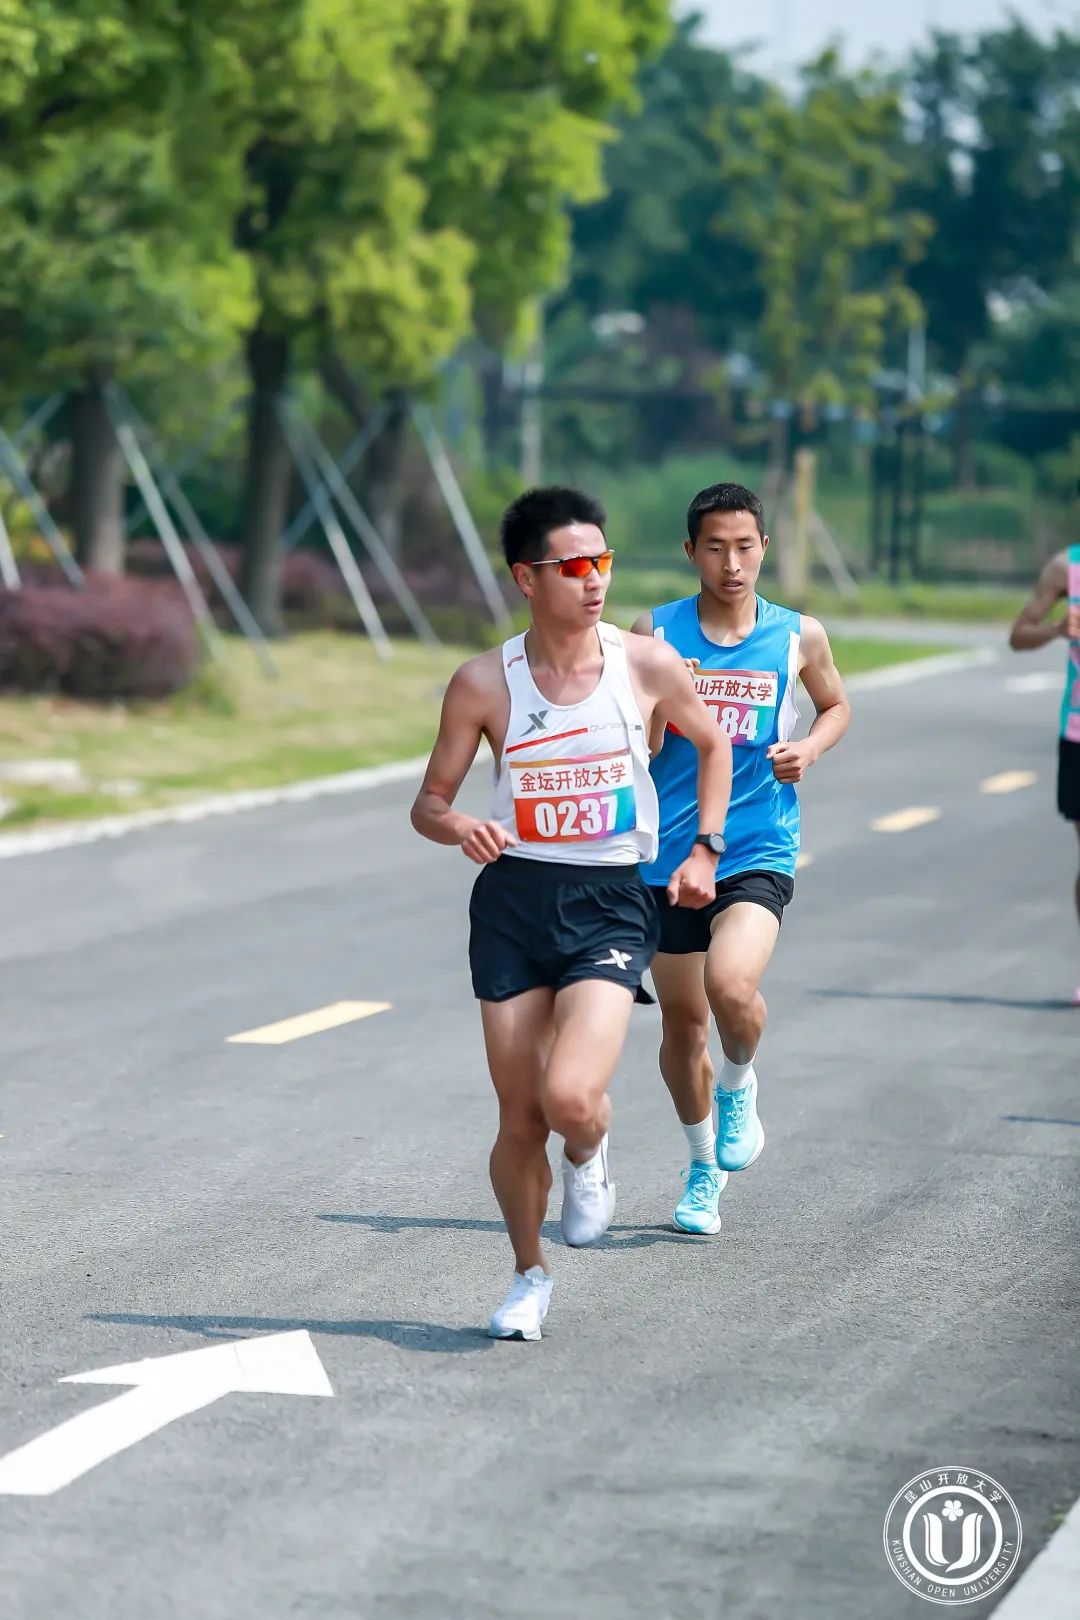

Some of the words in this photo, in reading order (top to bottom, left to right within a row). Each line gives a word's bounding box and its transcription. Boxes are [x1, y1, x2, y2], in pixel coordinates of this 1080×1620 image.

[519, 763, 626, 793] 金坛开放大学
[534, 794, 618, 838] 0237
